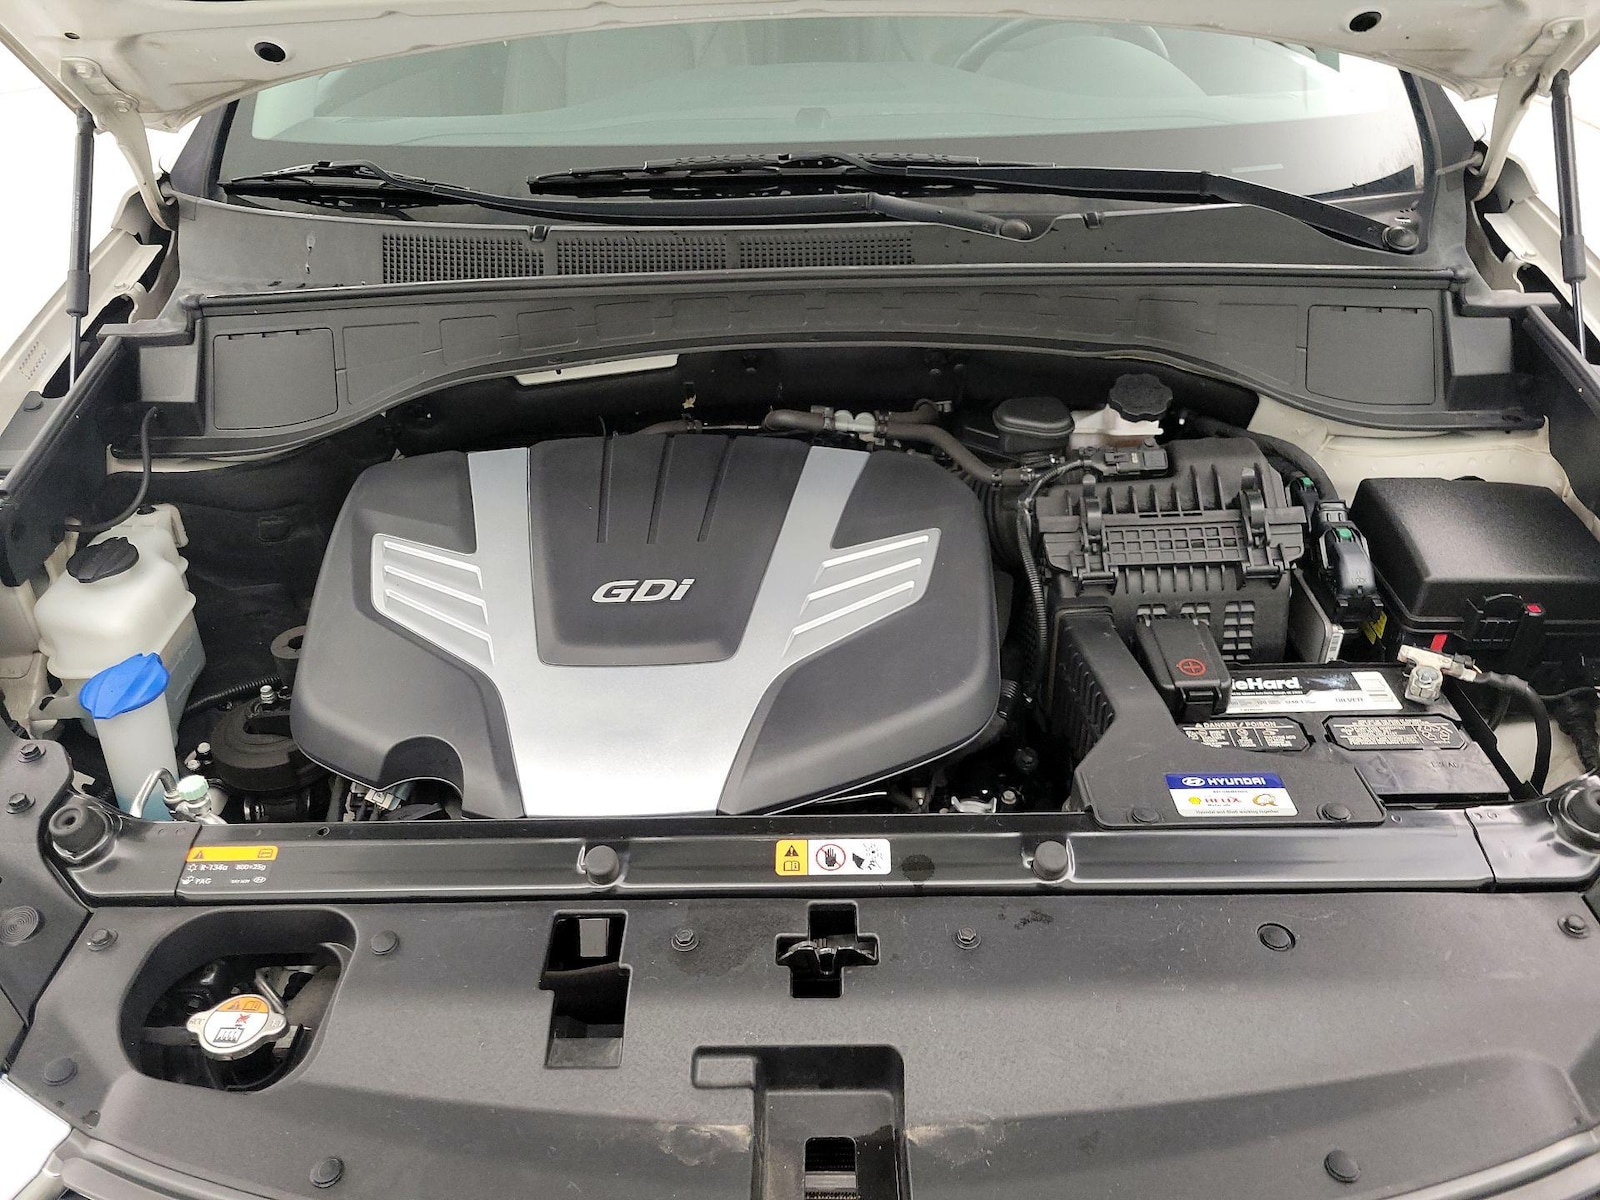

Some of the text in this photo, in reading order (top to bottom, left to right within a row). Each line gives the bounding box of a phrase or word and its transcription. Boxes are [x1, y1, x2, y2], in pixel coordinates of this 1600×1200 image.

[591, 578, 696, 603] GDi
[1207, 777, 1266, 786] HYUNDAI
[199, 863, 229, 872] R-134a
[195, 877, 212, 885] PAG
